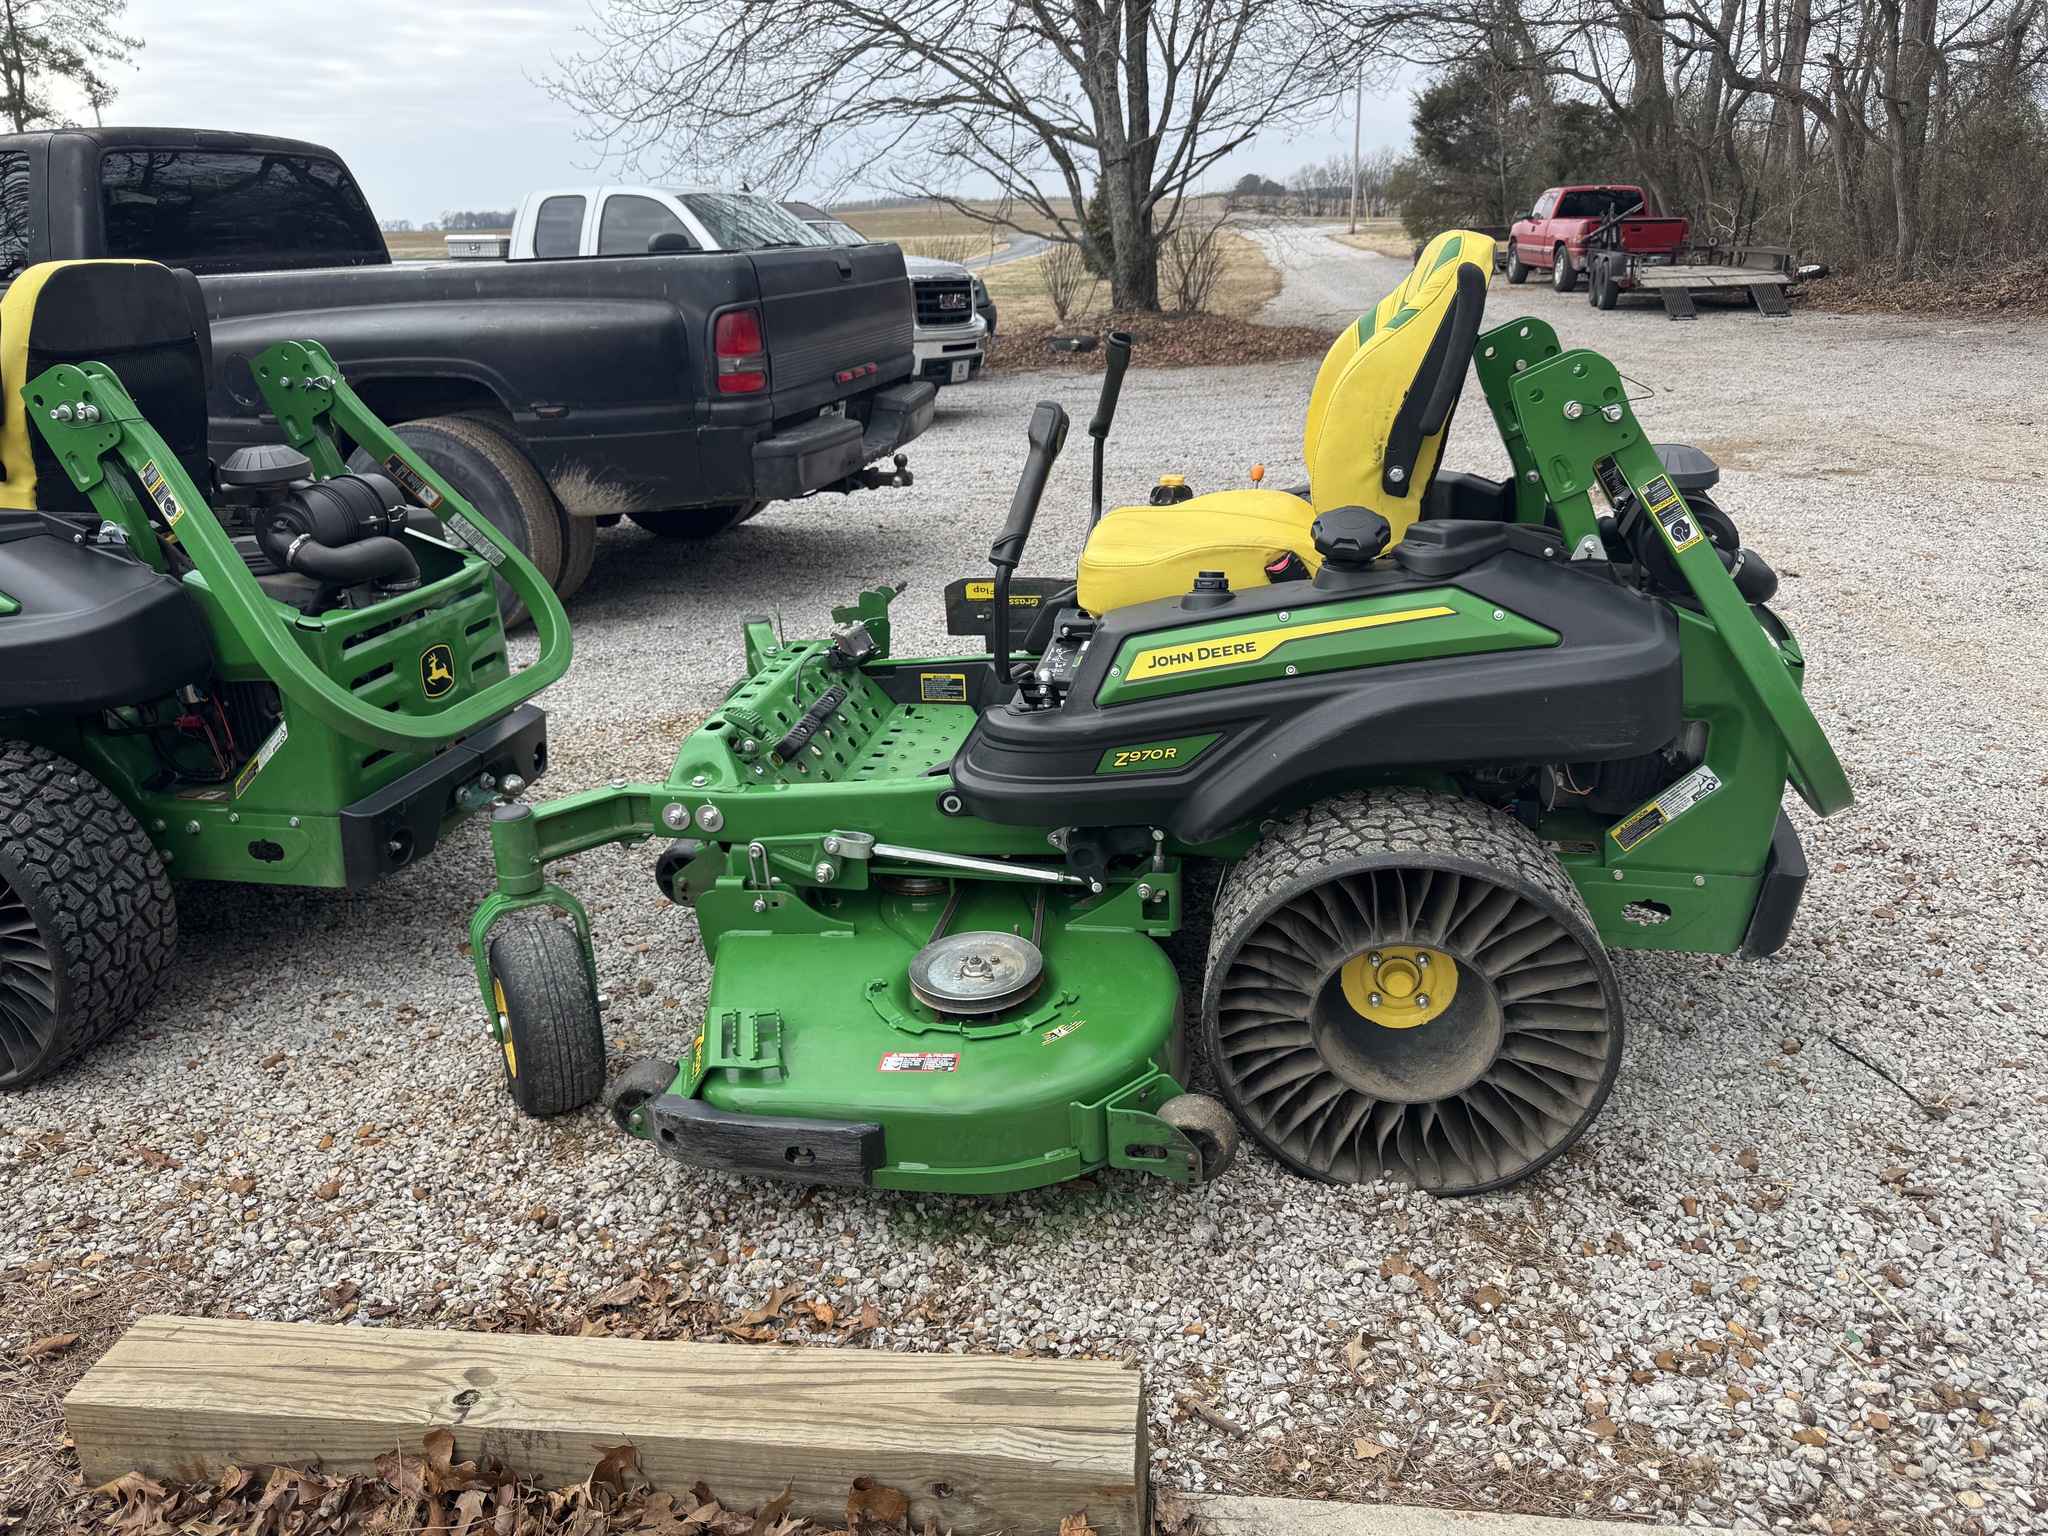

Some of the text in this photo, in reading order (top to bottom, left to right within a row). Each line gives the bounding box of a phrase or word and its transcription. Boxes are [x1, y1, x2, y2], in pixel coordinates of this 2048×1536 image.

[939, 293, 966, 309] GMC
[1009, 598, 1039, 607] Grass
[1148, 641, 1257, 669] JOHN DEERE
[1113, 748, 1177, 767] Z970R
